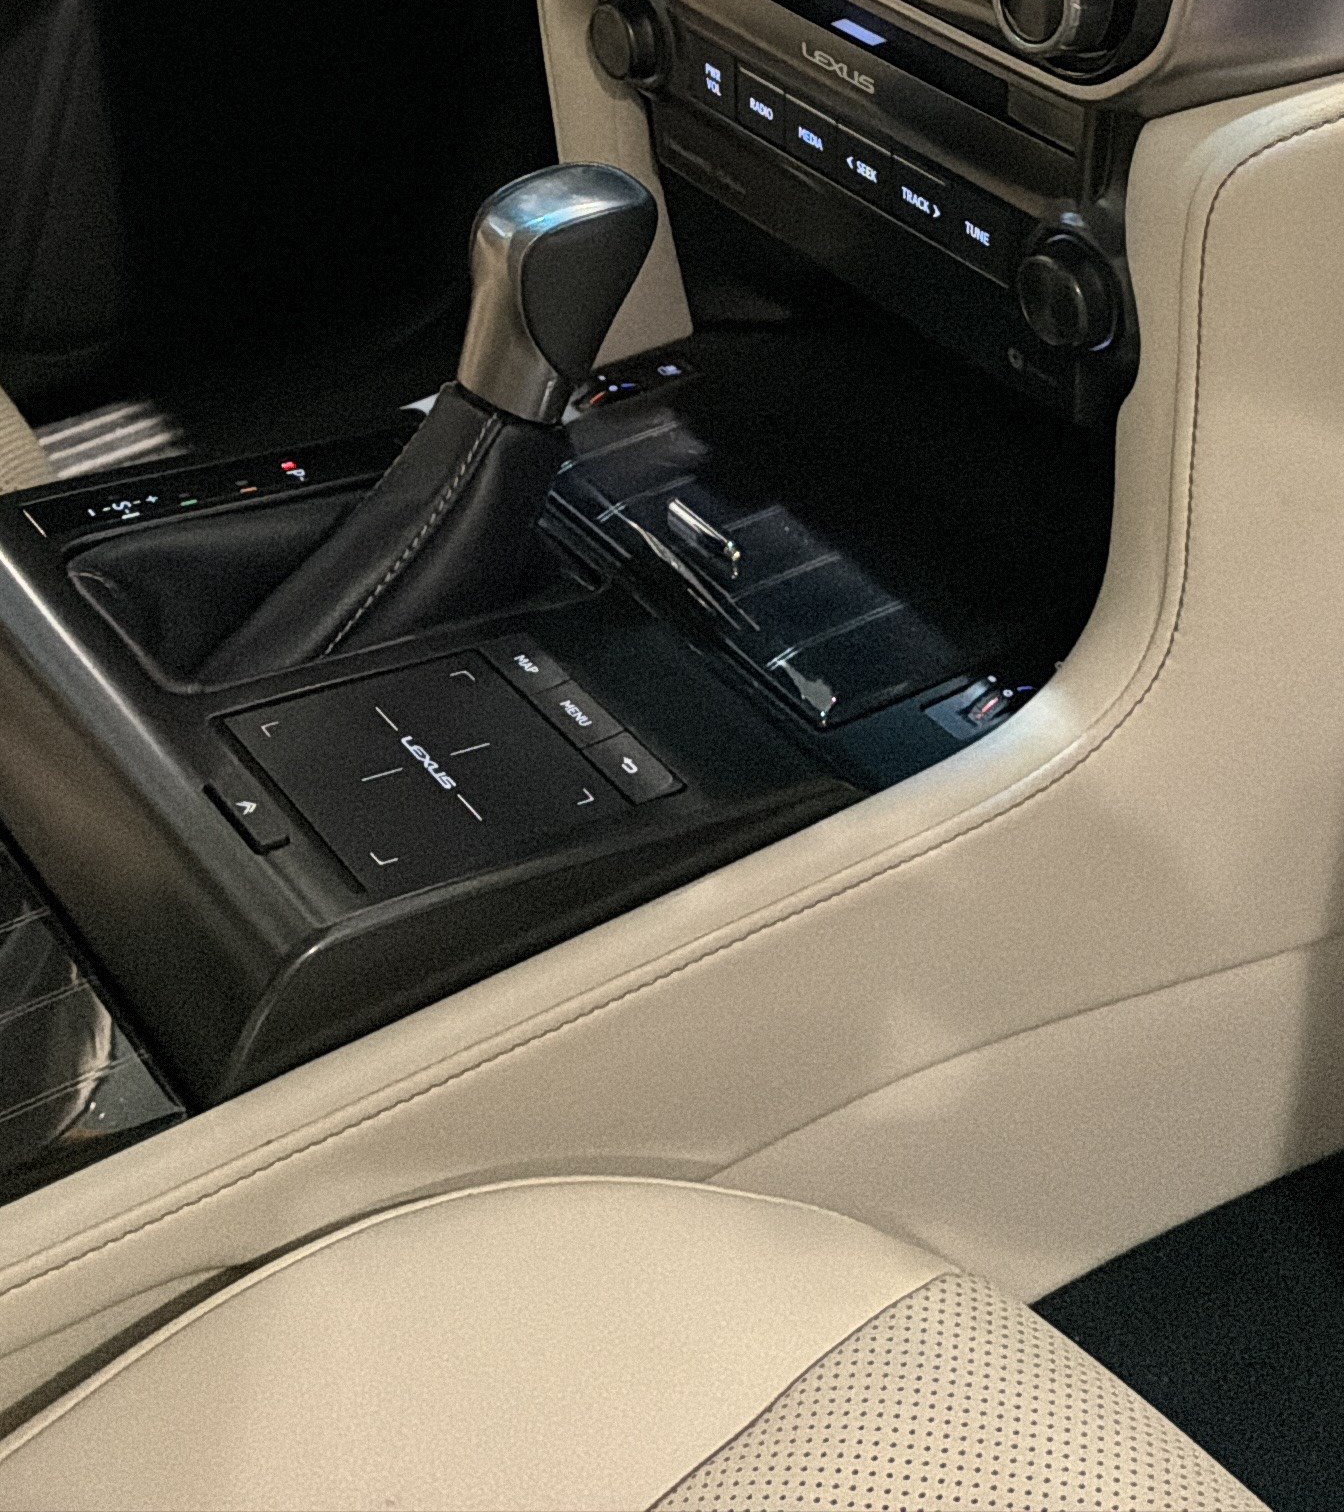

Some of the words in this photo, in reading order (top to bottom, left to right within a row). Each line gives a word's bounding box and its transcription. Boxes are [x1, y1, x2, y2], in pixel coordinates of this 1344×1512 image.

[801, 42, 875, 94] LEXUS
[706, 76, 722, 96] VOL
[749, 97, 774, 121] RADIO
[798, 125, 824, 151] MEDIA
[856, 160, 877, 184] SEEK
[901, 186, 931, 214] TRACK
[964, 220, 991, 247] TUNE
[514, 654, 539, 673] MAP
[559, 699, 592, 727] MENU
[400, 736, 457, 790] LEXUS
